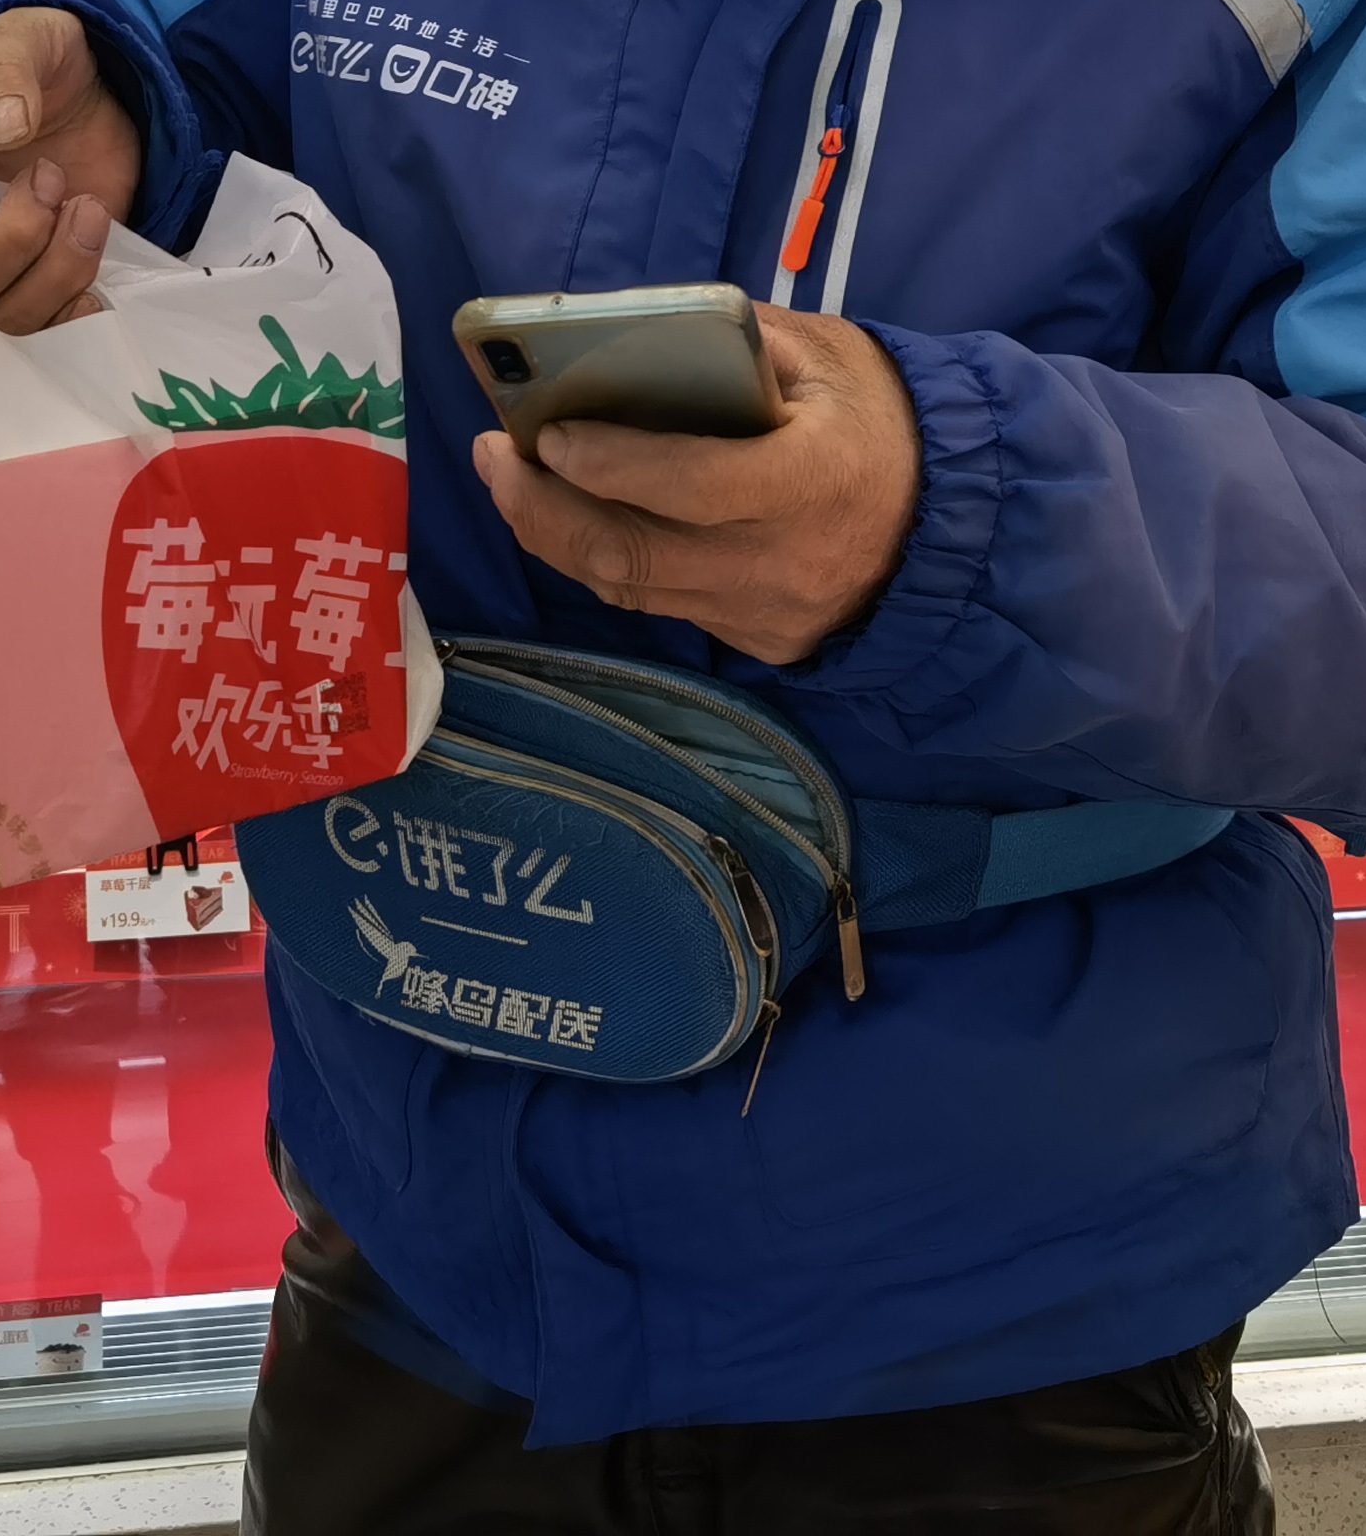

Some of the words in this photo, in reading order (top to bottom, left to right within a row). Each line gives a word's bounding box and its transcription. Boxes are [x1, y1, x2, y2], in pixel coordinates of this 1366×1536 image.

[423, 60, 519, 120] 口碑
[172, 672, 344, 772] 欢乐季
[228, 762, 297, 787] Strawberry
[298, 770, 345, 788] Season
[110, 854, 145, 867] HAPP
[200, 847, 225, 859] EAR
[392, 810, 594, 925] 饿了么
[100, 878, 152, 892] 草莓千层
[400, 965, 604, 1052] 蜂鸟配送
[12, 1302, 40, 1316] NEW
[46, 1299, 82, 1313] YEAR
